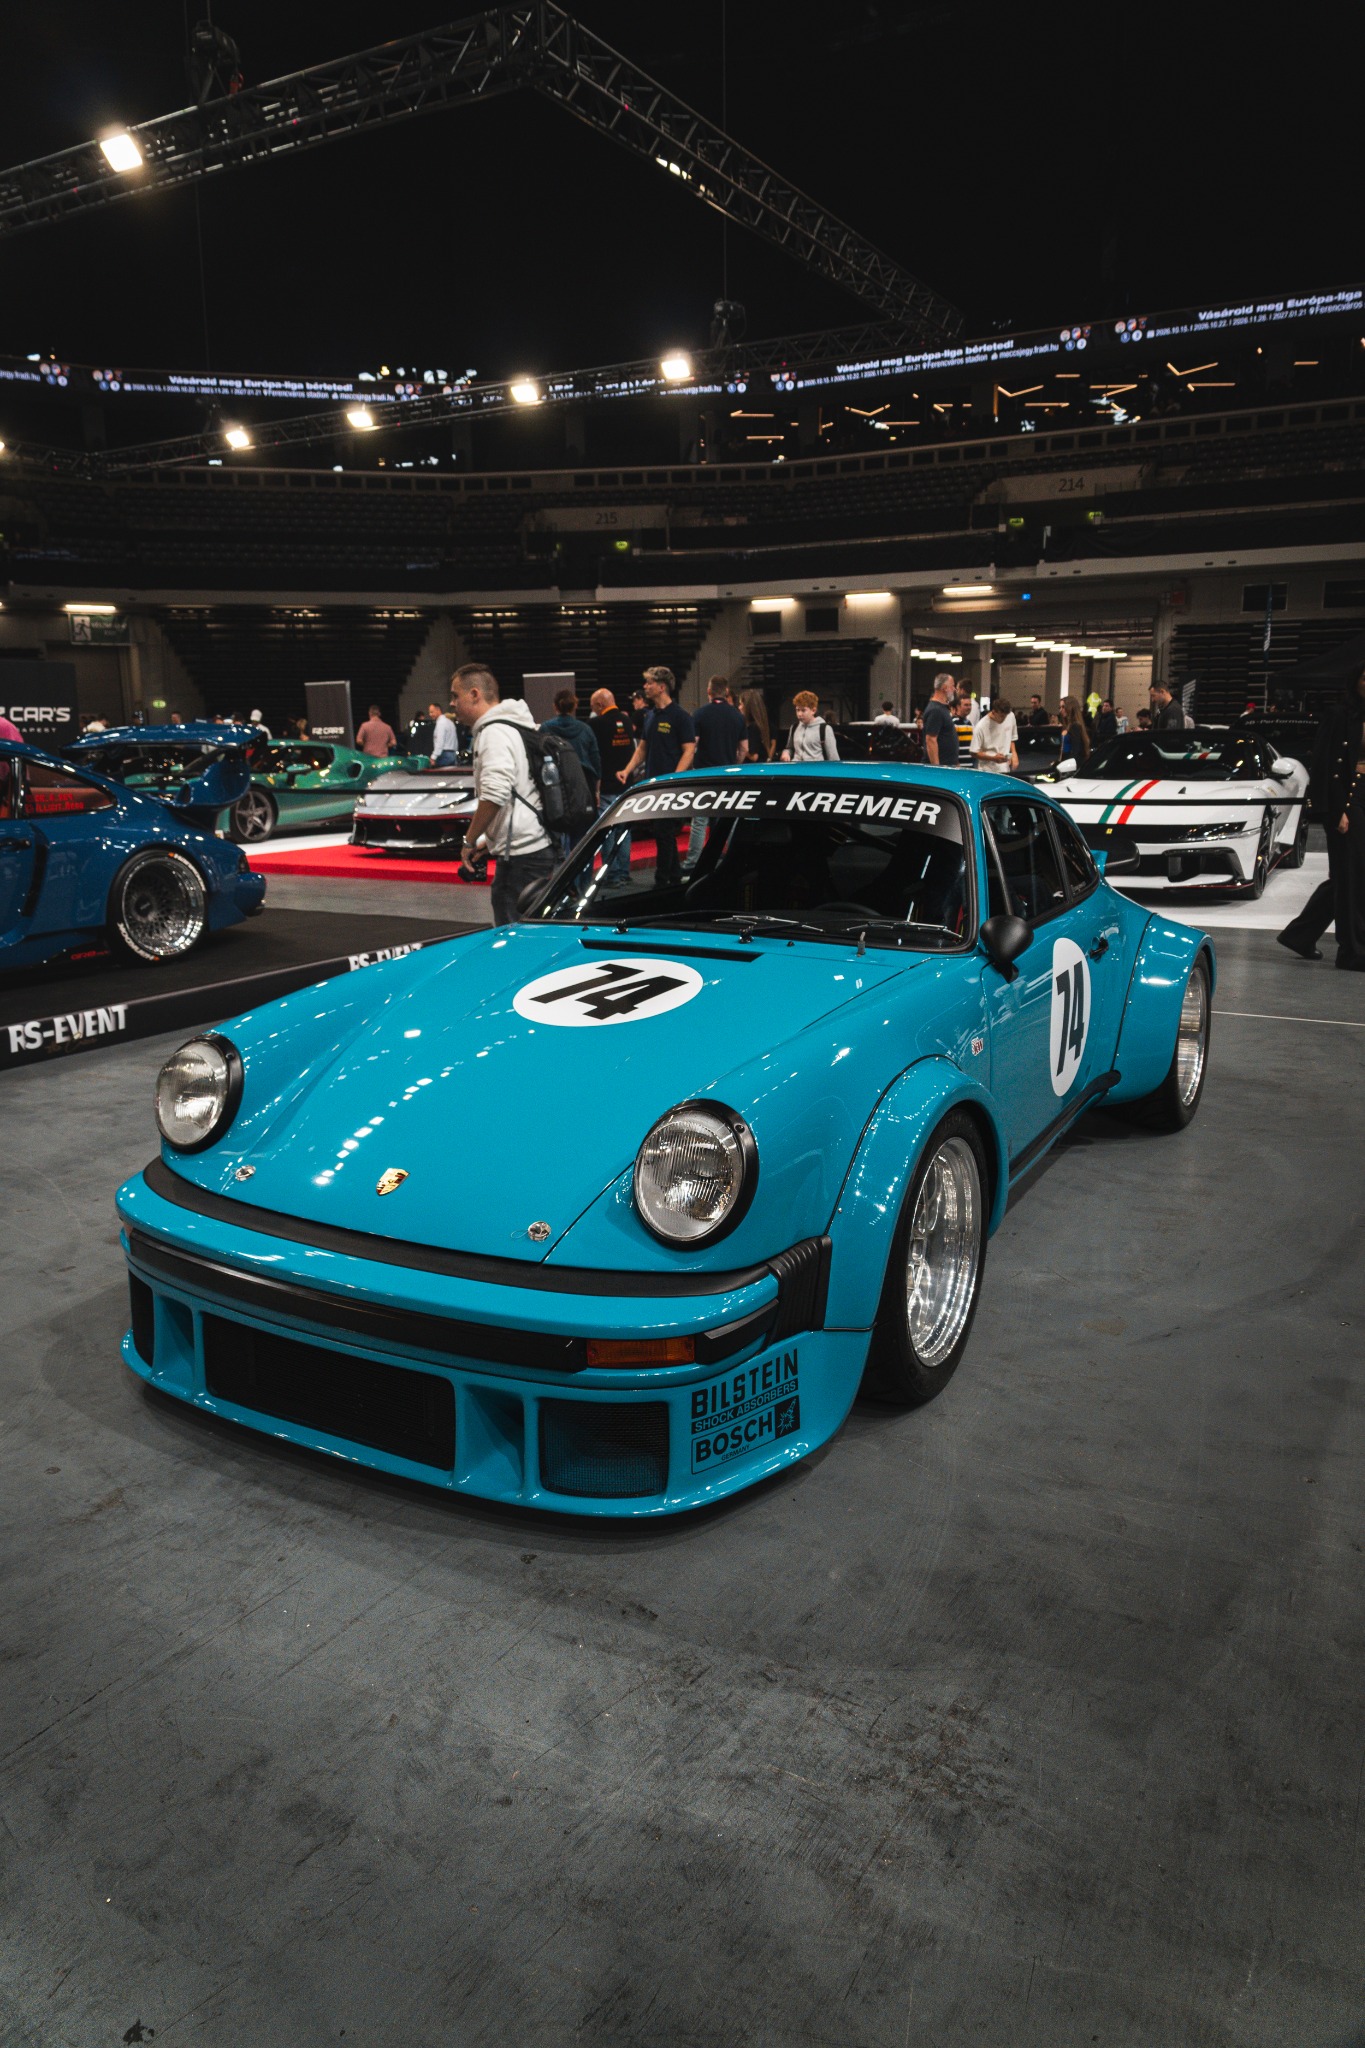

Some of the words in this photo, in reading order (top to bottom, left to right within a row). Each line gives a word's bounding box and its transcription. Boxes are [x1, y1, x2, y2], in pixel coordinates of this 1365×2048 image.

[1256, 301, 1284, 312] meg
[881, 357, 903, 368] meg
[218, 377, 242, 388] meg
[1058, 476, 1085, 492] 214
[595, 511, 618, 525] 215
[9, 706, 71, 722] CAR'S
[615, 790, 761, 817] PORSCHE
[786, 791, 942, 825] KREMER
[528, 963, 689, 1020] 14
[8, 1004, 128, 1054] RS-EVENT
[1056, 960, 1085, 1077] 14
[692, 1348, 798, 1419] BILSTEIN
[695, 1409, 734, 1432] SHOCK
[736, 1380, 796, 1416] ABSORBERS
[696, 1411, 773, 1463] BOSCH
[721, 1444, 751, 1461] GERMANY
